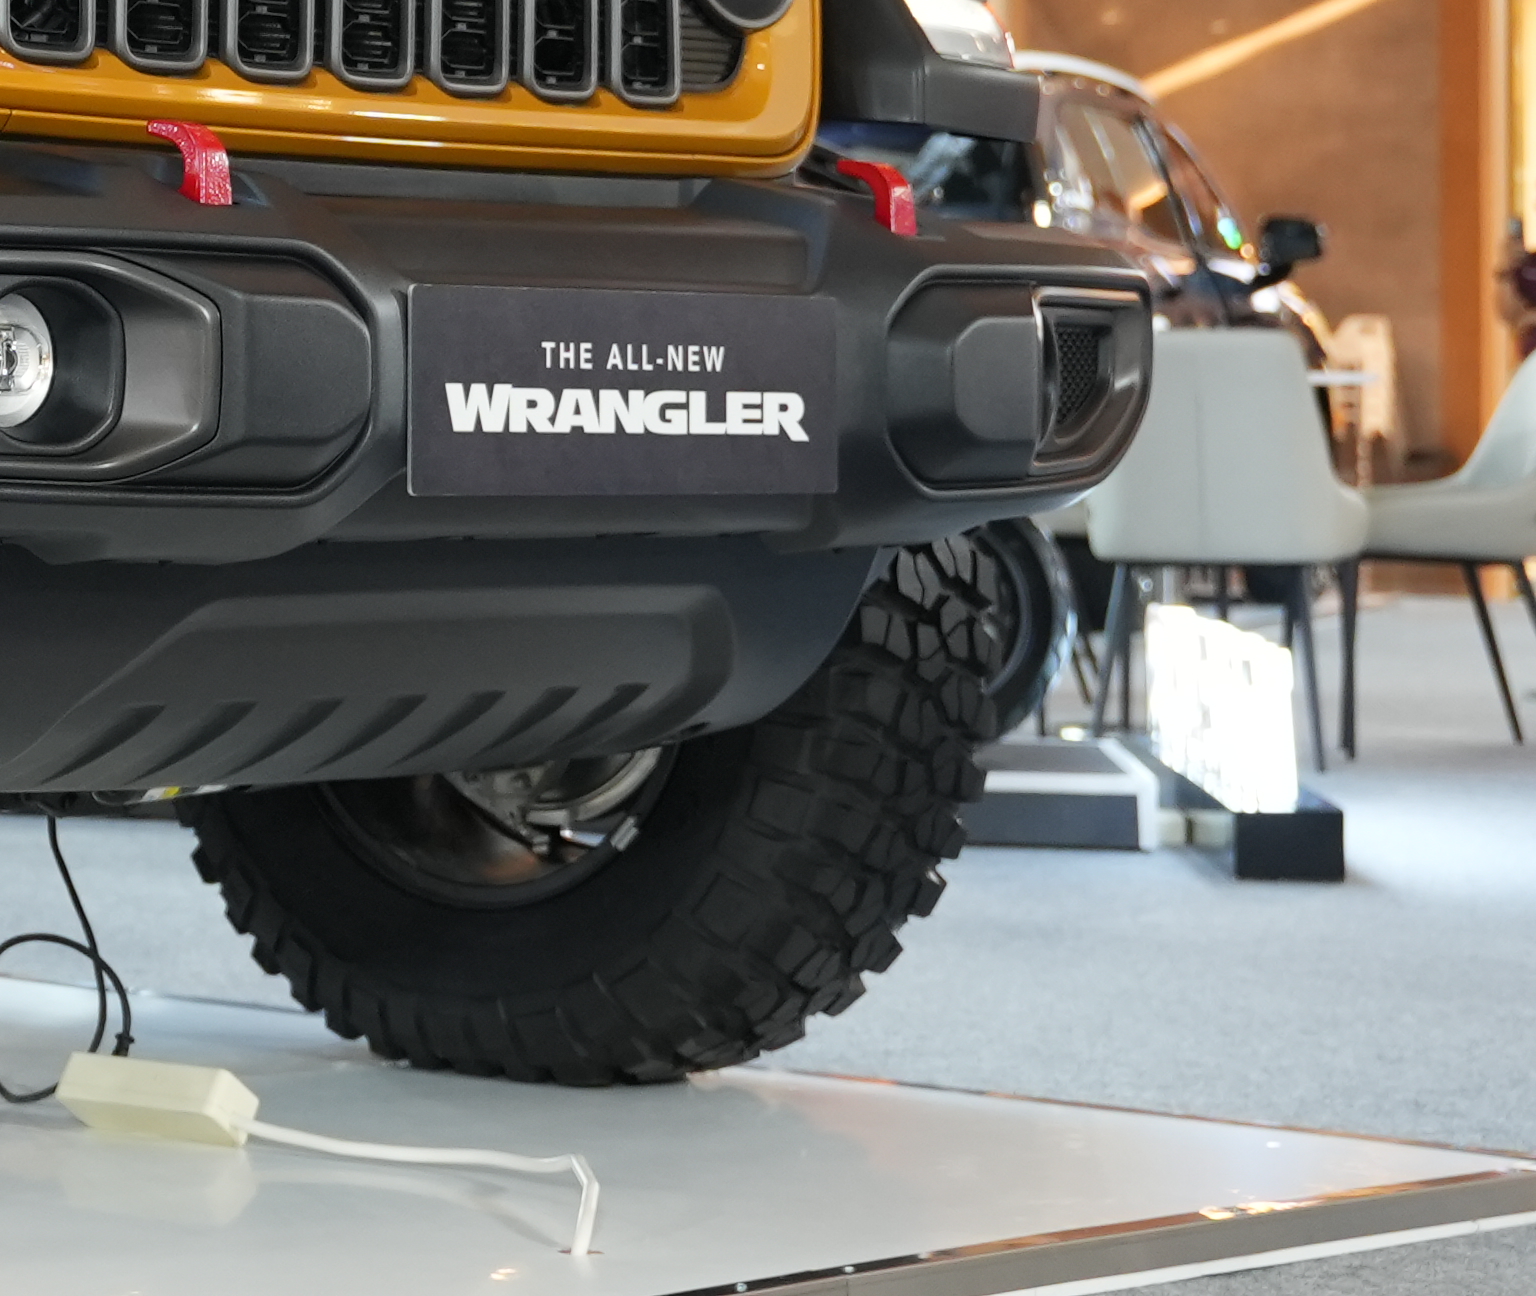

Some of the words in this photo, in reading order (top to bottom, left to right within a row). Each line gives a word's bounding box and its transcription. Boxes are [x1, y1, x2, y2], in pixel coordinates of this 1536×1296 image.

[541, 341, 594, 370] THE
[606, 343, 725, 372] ALL-NEW
[444, 383, 810, 442] WRANGLER
